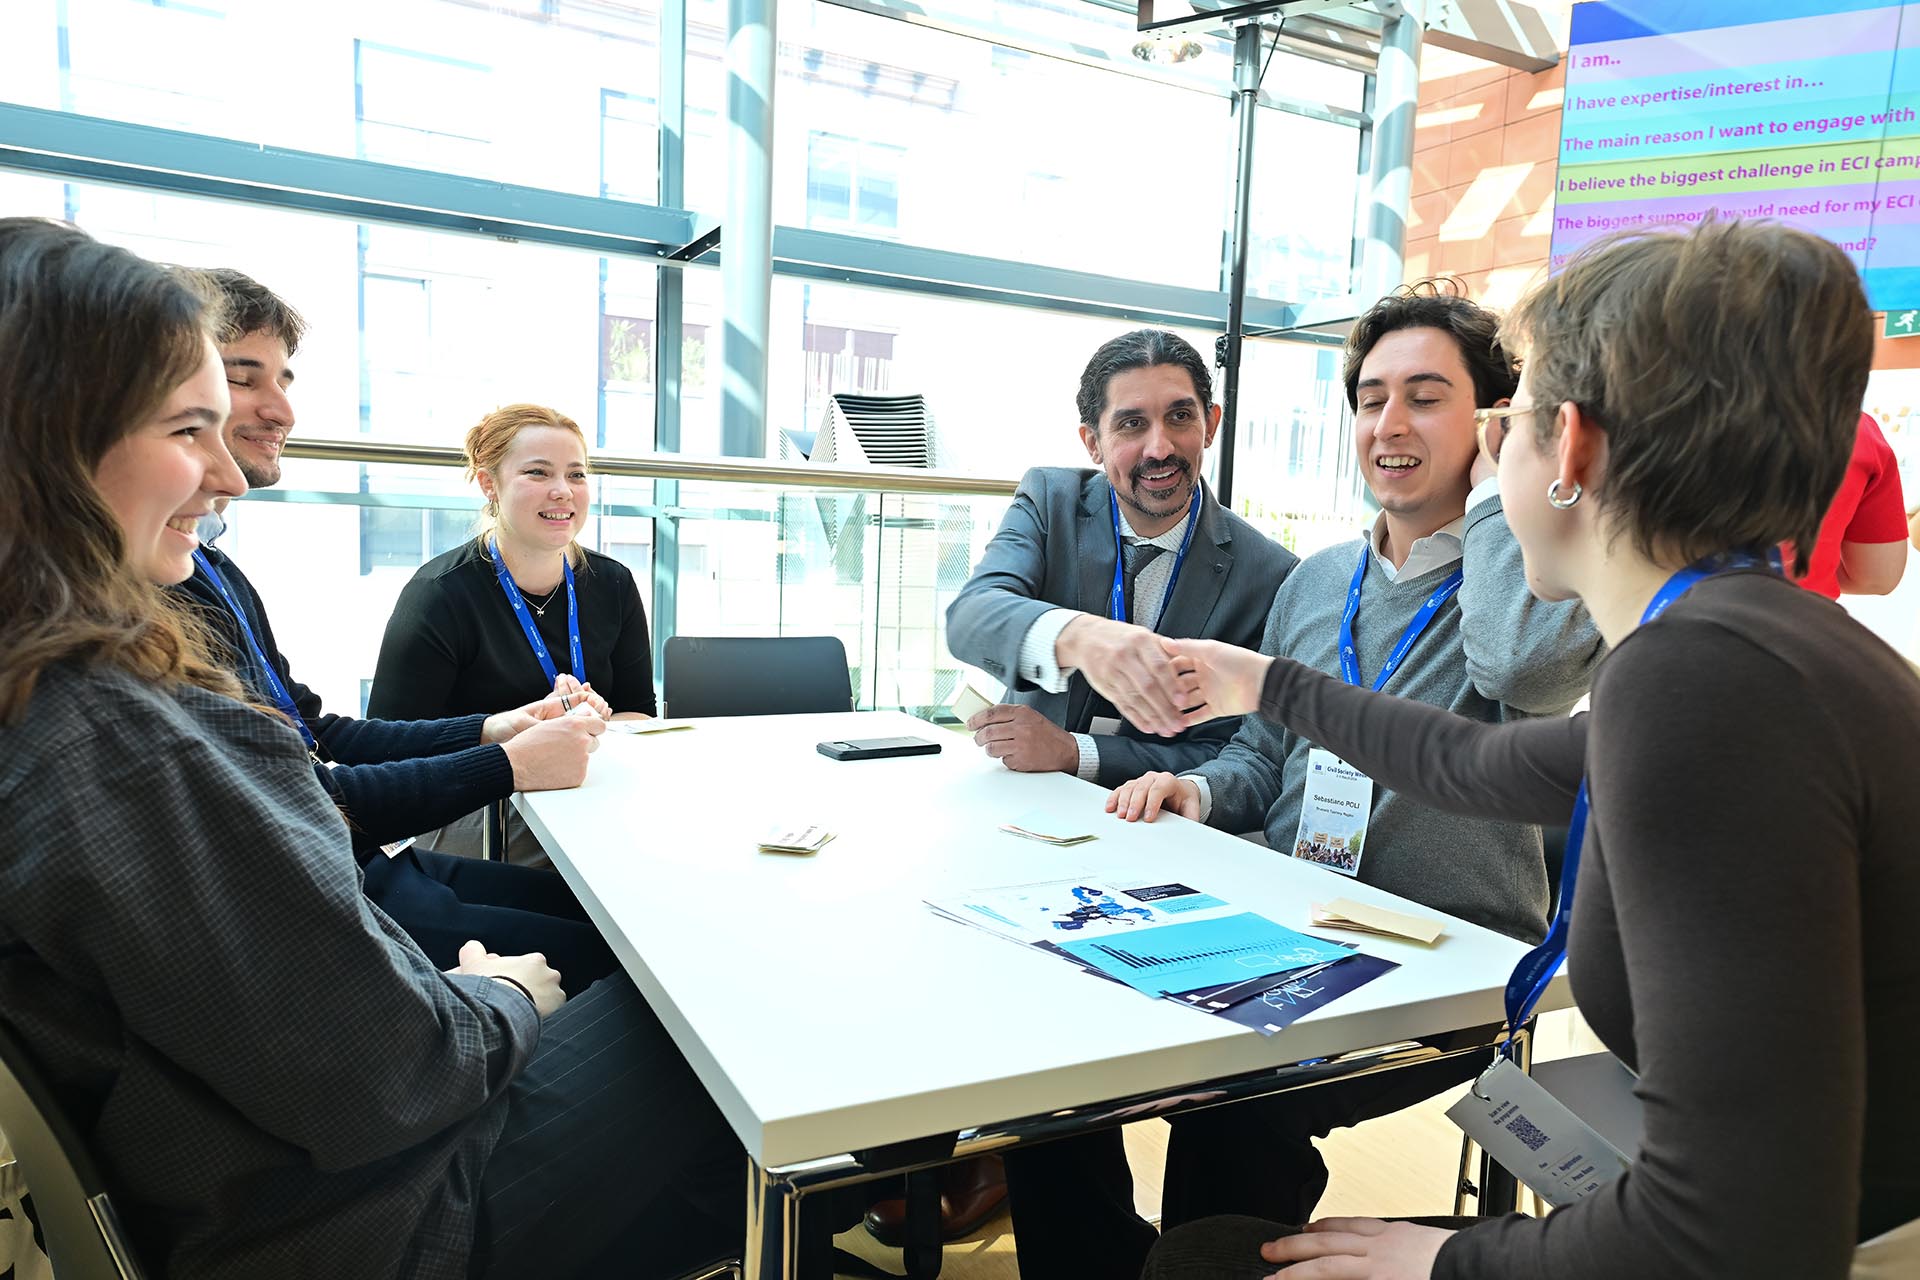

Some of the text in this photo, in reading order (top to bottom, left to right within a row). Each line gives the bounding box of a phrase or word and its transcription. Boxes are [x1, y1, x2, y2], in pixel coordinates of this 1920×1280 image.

[1570, 54, 1621, 69] I am..
[1566, 98, 1572, 111] I
[1576, 96, 1616, 110] have
[1620, 77, 1781, 107] expertise/interest
[1564, 107, 1915, 151] The main reason I want to engage with
[1560, 179, 1565, 192] I
[1568, 177, 1625, 192] believe
[1630, 173, 1656, 187] the
[1660, 169, 1723, 187] biggest
[1728, 162, 1814, 180] challenge
[1819, 159, 1836, 173] in
[1841, 156, 1870, 171] ECI
[1557, 217, 1584, 230] The
[1587, 212, 1643, 229] biggest
[1778, 201, 1820, 216] need
[1825, 199, 1850, 213] for
[1854, 201, 1881, 214] my
[1886, 194, 1914, 209] ECI
